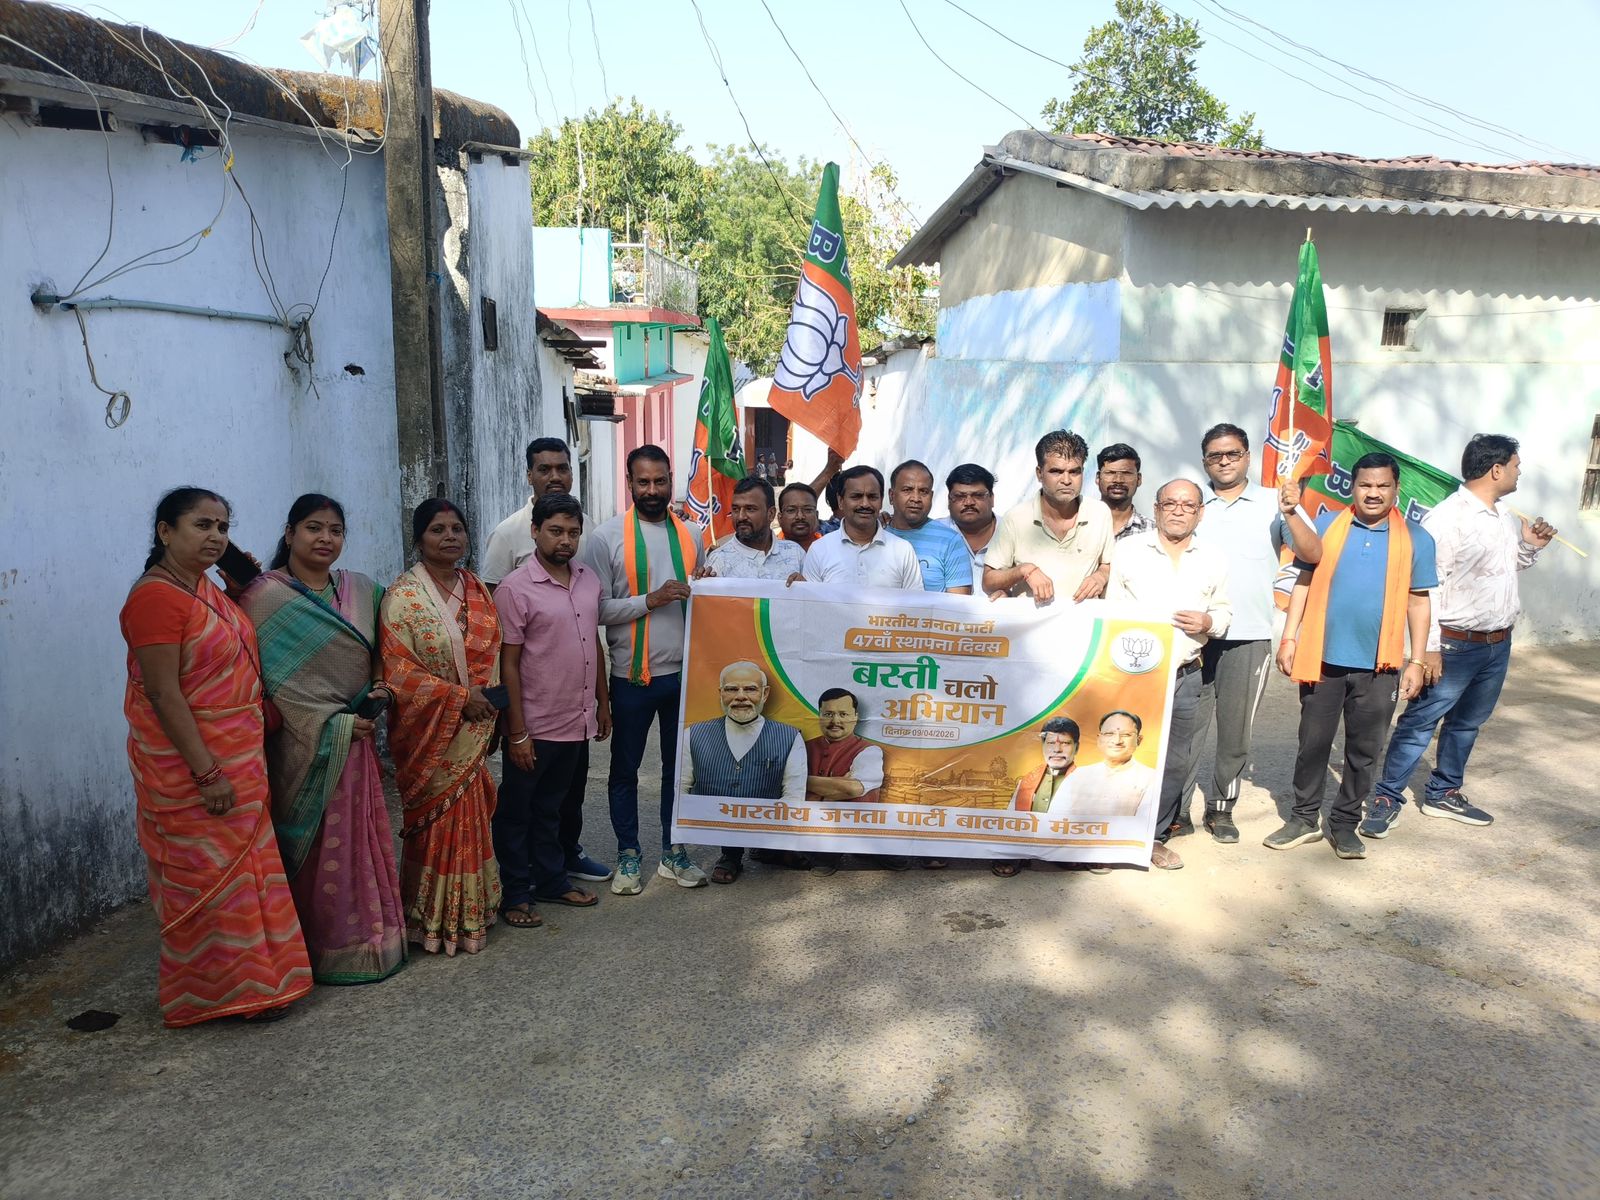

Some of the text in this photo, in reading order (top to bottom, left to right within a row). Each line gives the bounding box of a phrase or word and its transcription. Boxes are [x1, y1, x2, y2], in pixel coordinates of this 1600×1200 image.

[868, 614, 995, 634] भारतीय जनता पार्टी
[852, 630, 1002, 653] 47वाँ स्थापना दिवस
[851, 655, 998, 700] बस्ती चलो
[880, 693, 1007, 726] अभियान
[885, 726, 955, 739] दिनांक 09/04/2026
[719, 801, 1110, 835] भारतीय जनता पार्टी बालको मंडल
